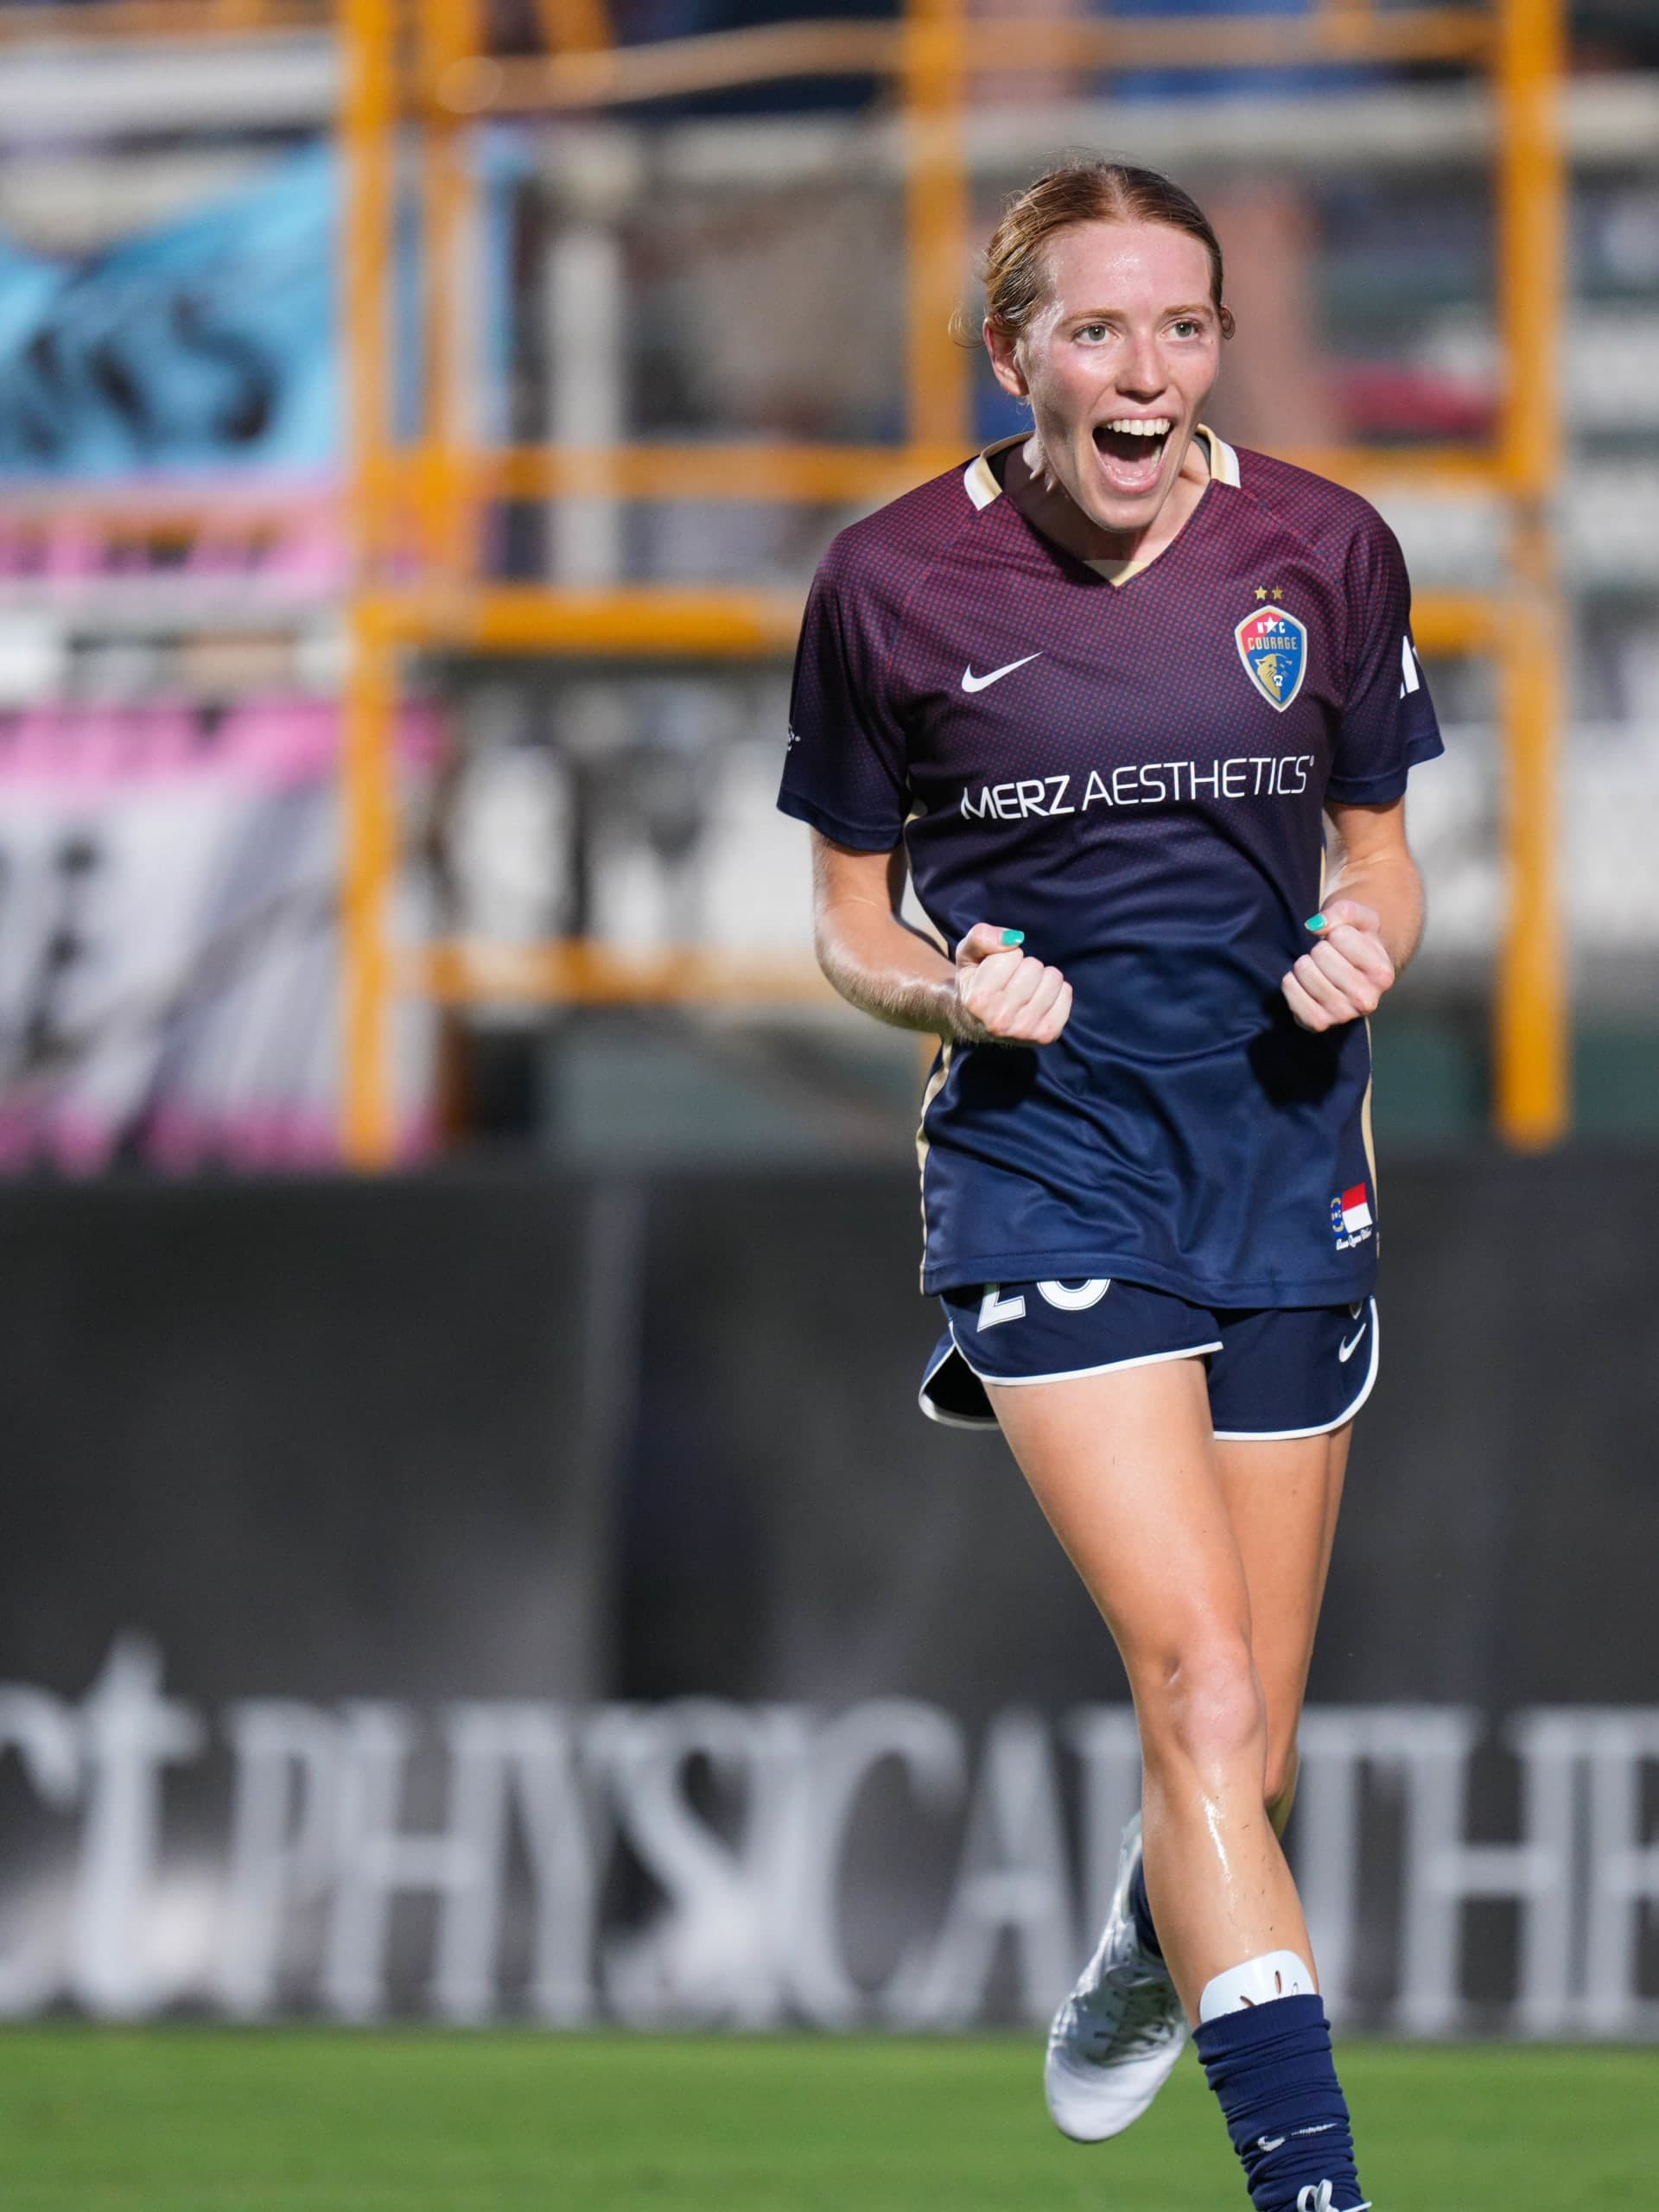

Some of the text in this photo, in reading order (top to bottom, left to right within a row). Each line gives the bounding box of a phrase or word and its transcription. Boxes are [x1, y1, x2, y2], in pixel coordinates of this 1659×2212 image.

[1247, 636, 1298, 651] COURAGE
[960, 754, 1310, 820] MERZ AESTHETICS
